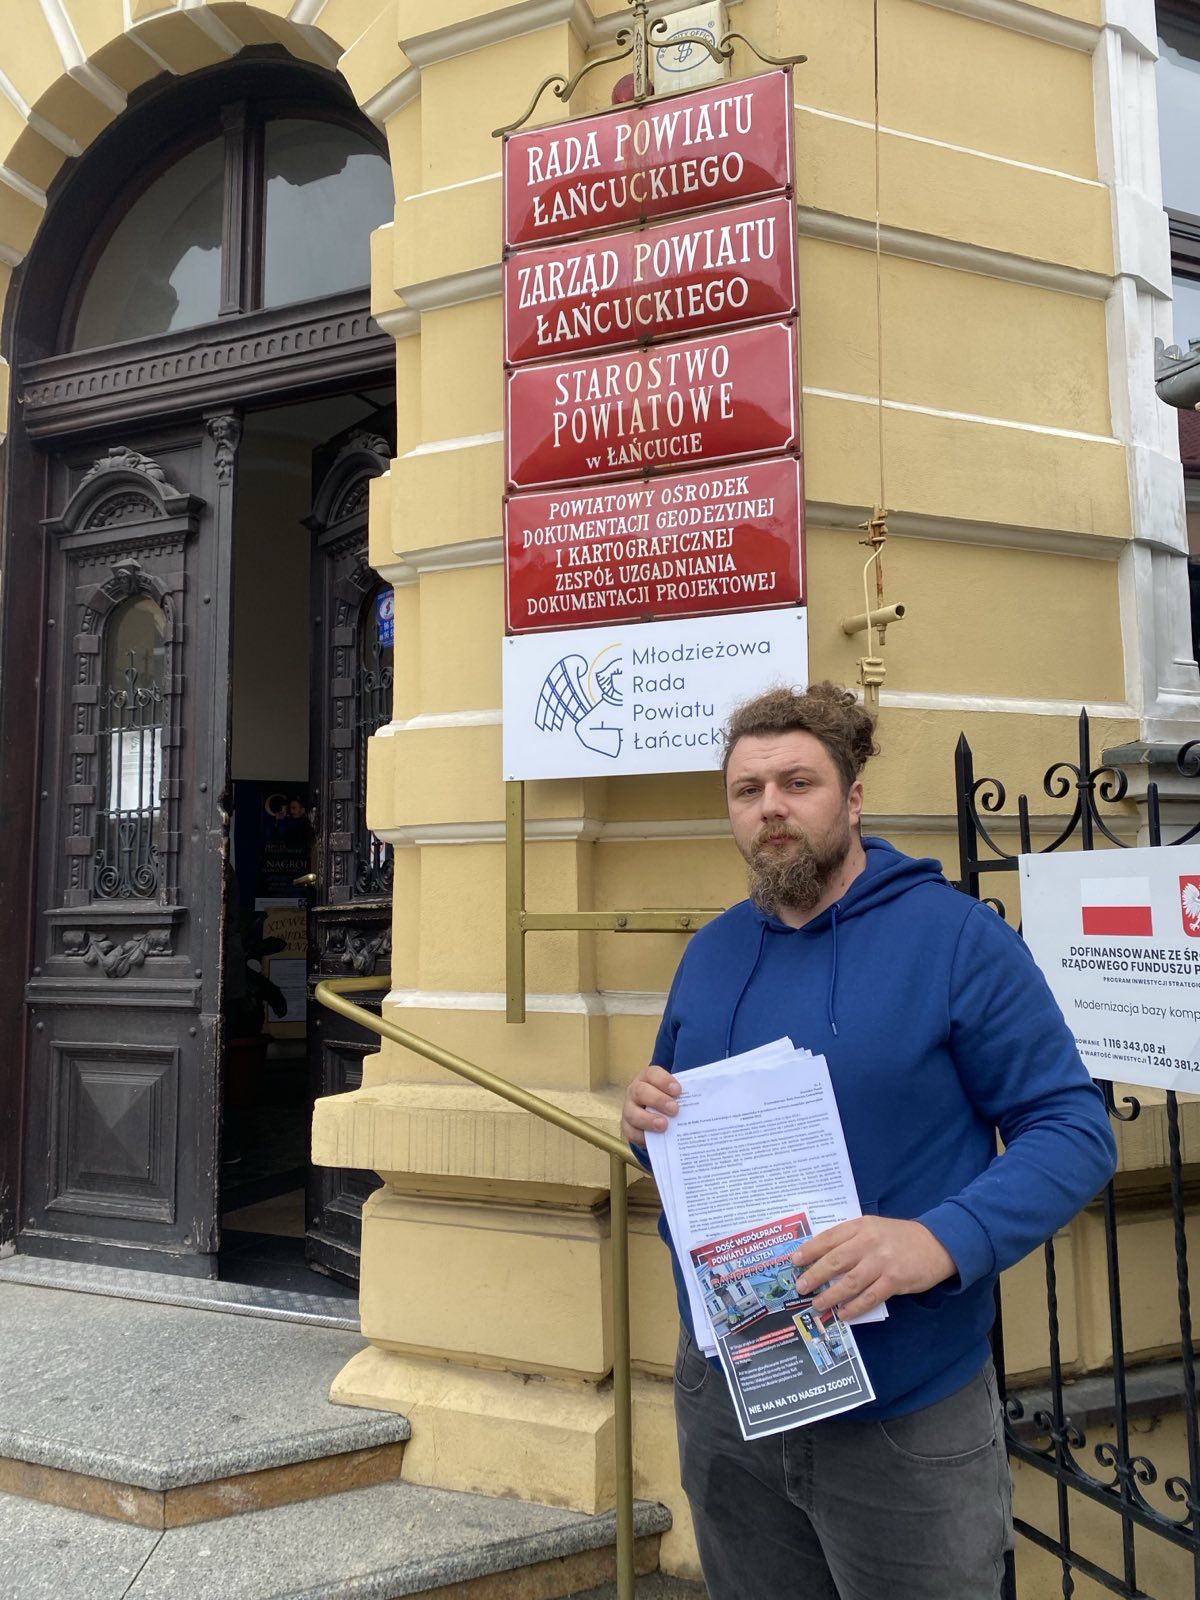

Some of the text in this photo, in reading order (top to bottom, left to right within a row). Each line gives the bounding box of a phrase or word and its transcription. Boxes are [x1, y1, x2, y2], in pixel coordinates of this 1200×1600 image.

[527, 93, 754, 186] RADA POWIATU
[533, 151, 744, 227] ŁAŃCUCKIEGO
[518, 216, 776, 310] ZARZĄD POWIATU
[536, 276, 749, 346] ŁAŃCUCKIEGO
[555, 345, 729, 406] STAROSTWO
[553, 382, 734, 448] POWIATOWE
[586, 432, 703, 469] w ŁAŃCUCIE
[549, 475, 749, 520] POWIATOWY OŚRODEK
[522, 497, 775, 549] DOKUMENTACJI GEODEZYJNEJ
[556, 528, 734, 568] I KARTOGRAFICZNEJ
[555, 553, 737, 592] ZESPÓŁ UZGADNIANIA
[527, 572, 776, 615] DOKUMENTACJI PROJEKTOWEJ
[632, 639, 771, 666] Młodzieżowa
[633, 674, 685, 693] Rada
[633, 700, 714, 722] Powiatu
[1062, 958, 1128, 971] RZĄDOWEGO
[1131, 962, 1191, 974] FUNDUSZU
[1070, 946, 1200, 961] DOFINANSOWANE ZE ŚR
[1103, 976, 1131, 984] PROGRAM
[1132, 979, 1167, 987] INWESTYCJI
[1074, 999, 1139, 1016] Modernizacja
[1141, 1004, 1167, 1019] bazy
[1075, 1038, 1100, 1046] SOWANIE
[1123, 1040, 1155, 1054] 343,08
[1157, 1044, 1166, 1055] zł
[1085, 1050, 1111, 1059] WARTOŚĆ
[1112, 1054, 1147, 1064] INWESTYCJI
[711, 1232, 793, 1266] POWIATU ŁAŃCUCKIEGO
[715, 1240, 735, 1253] DOŚĆ
[735, 1224, 783, 1247] WSPÓŁPRACY
[711, 1252, 795, 1289] BANDEROWSK
[737, 1250, 774, 1268] Z MIASTEM
[748, 1375, 856, 1415] NIE MA NA TO NASZEJ ZGODY!
